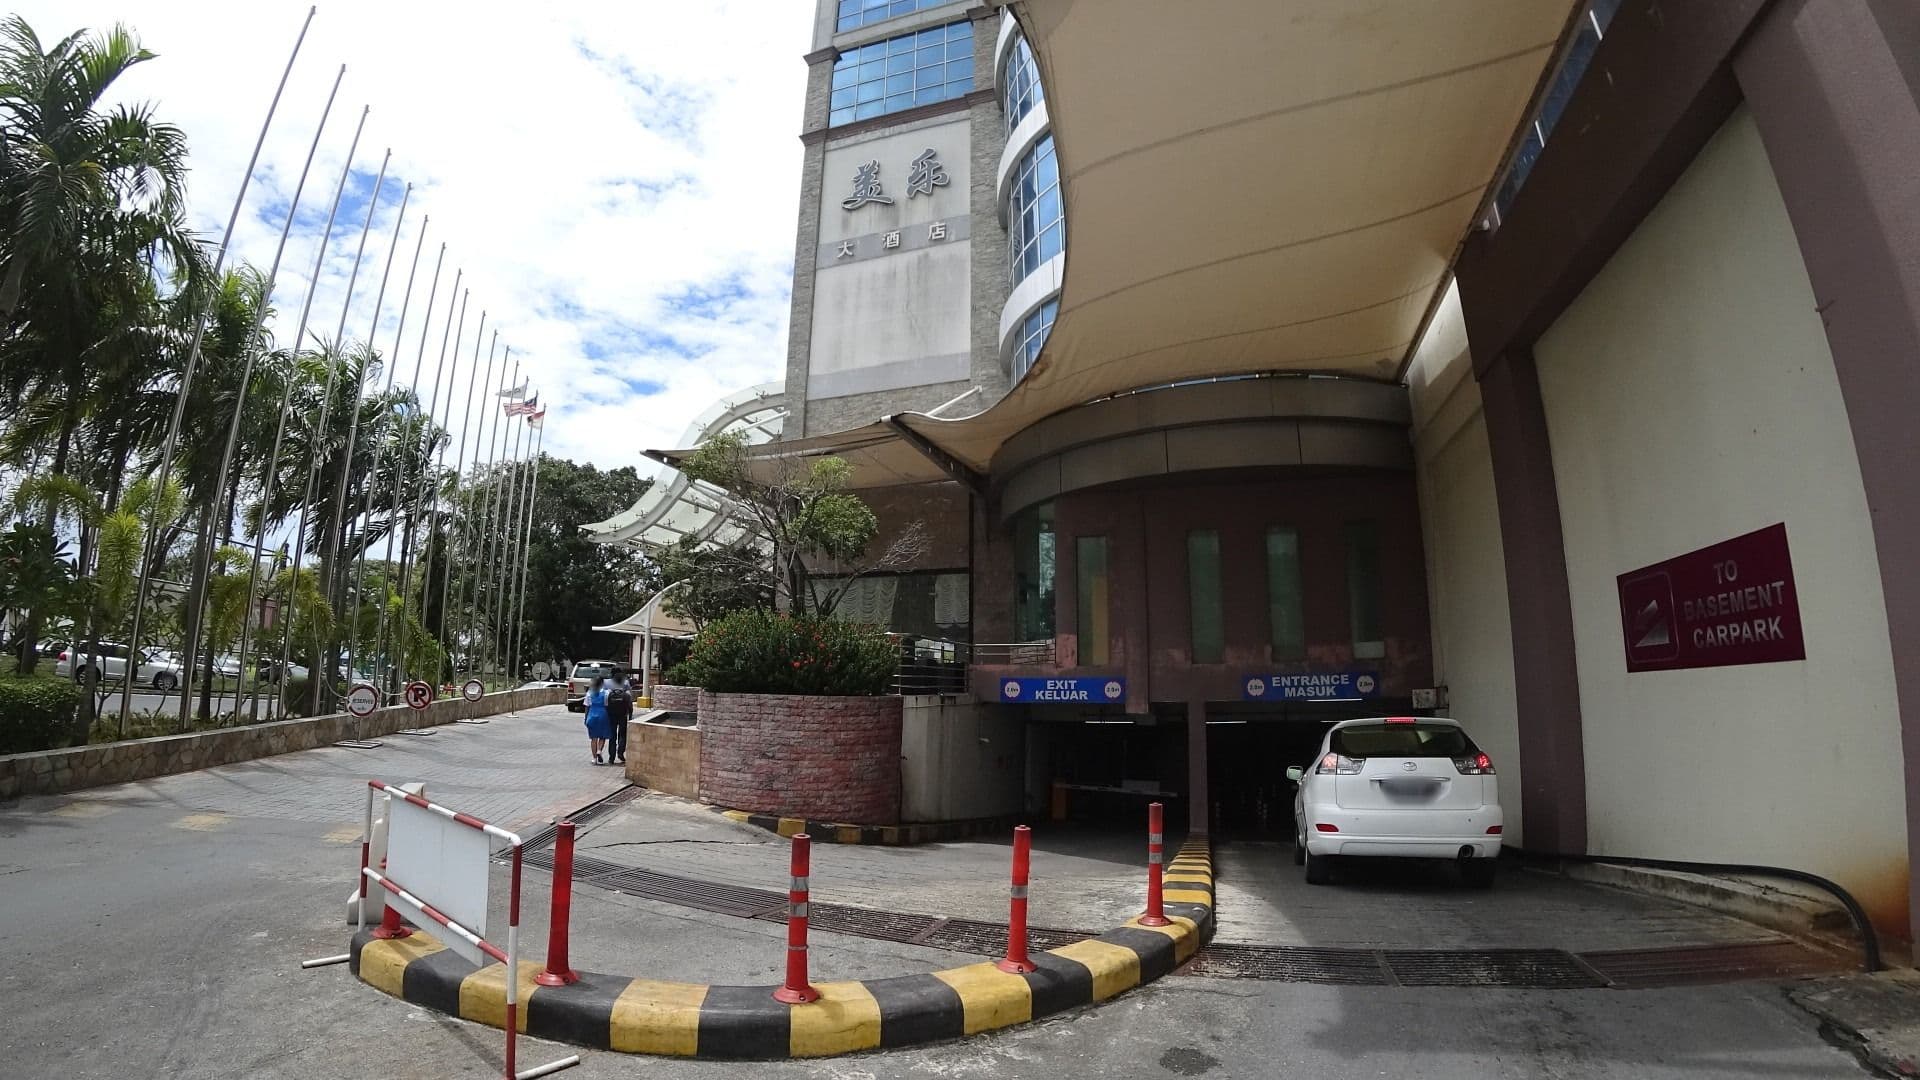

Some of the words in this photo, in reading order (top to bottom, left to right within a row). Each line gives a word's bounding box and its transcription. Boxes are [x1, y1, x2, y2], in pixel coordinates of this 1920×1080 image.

[837, 222, 946, 258] 大酒店
[1713, 560, 1738, 584] TO
[1684, 581, 1785, 621] BASEMENT
[1693, 616, 1785, 648] CARPARK
[1046, 680, 1078, 690] EXIT
[1271, 674, 1350, 687] ENTRANCE
[1035, 690, 1089, 700] KELUAR
[1285, 686, 1337, 698] MASUK
